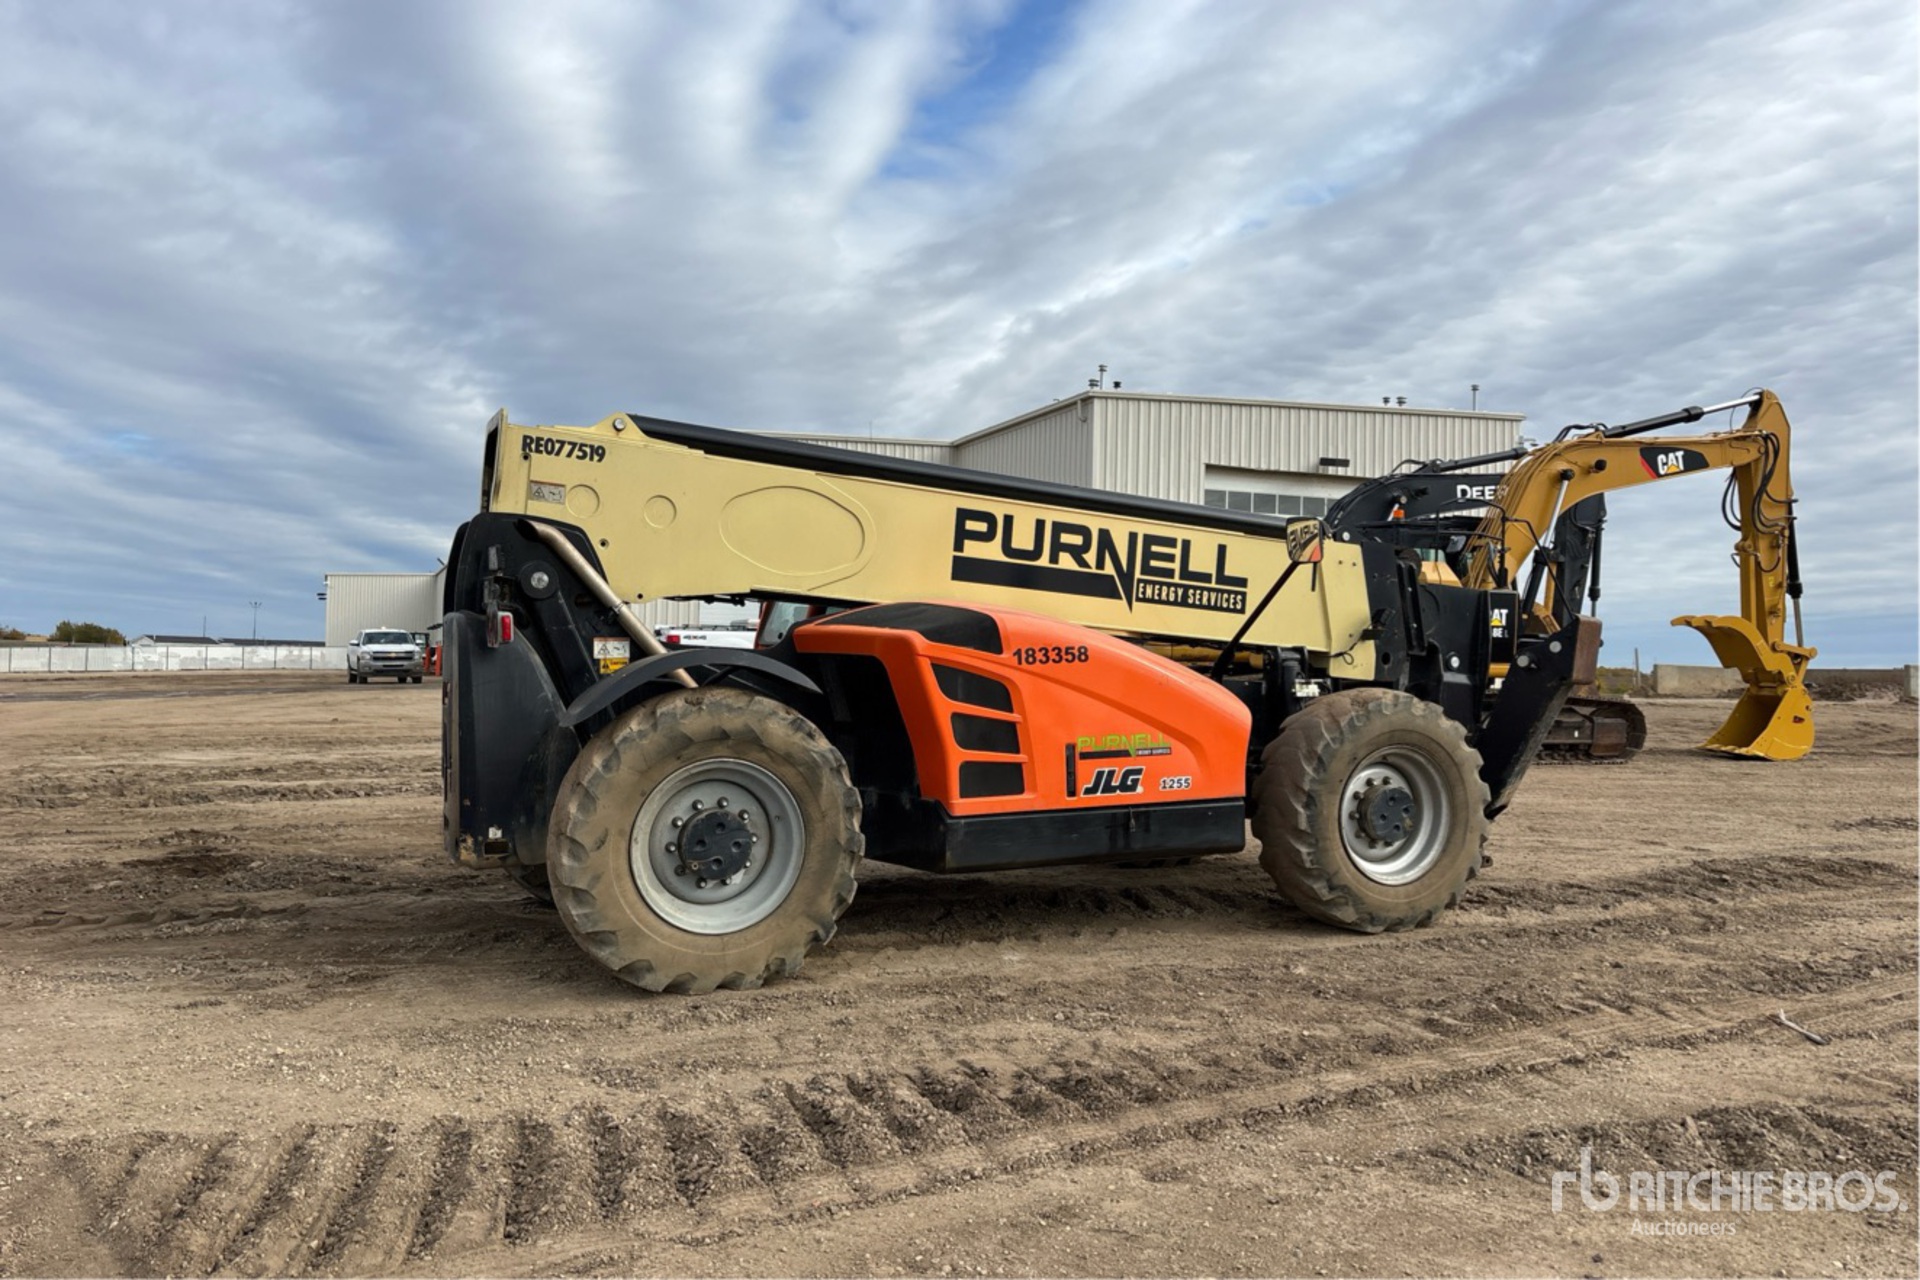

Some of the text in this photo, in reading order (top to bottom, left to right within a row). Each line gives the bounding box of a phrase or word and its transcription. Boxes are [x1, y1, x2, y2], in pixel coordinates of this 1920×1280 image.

[522, 435, 606, 463] RE077519
[1657, 450, 1684, 475] CAT
[953, 507, 1248, 614] PURNELL
[1138, 582, 1243, 610] ENERGY SERVICES
[1490, 608, 1509, 626] AT
[1013, 645, 1089, 666] 183358
[1077, 733, 1171, 757] PURNELL
[1082, 767, 1144, 796] JLG
[1160, 777, 1191, 790] 1255
